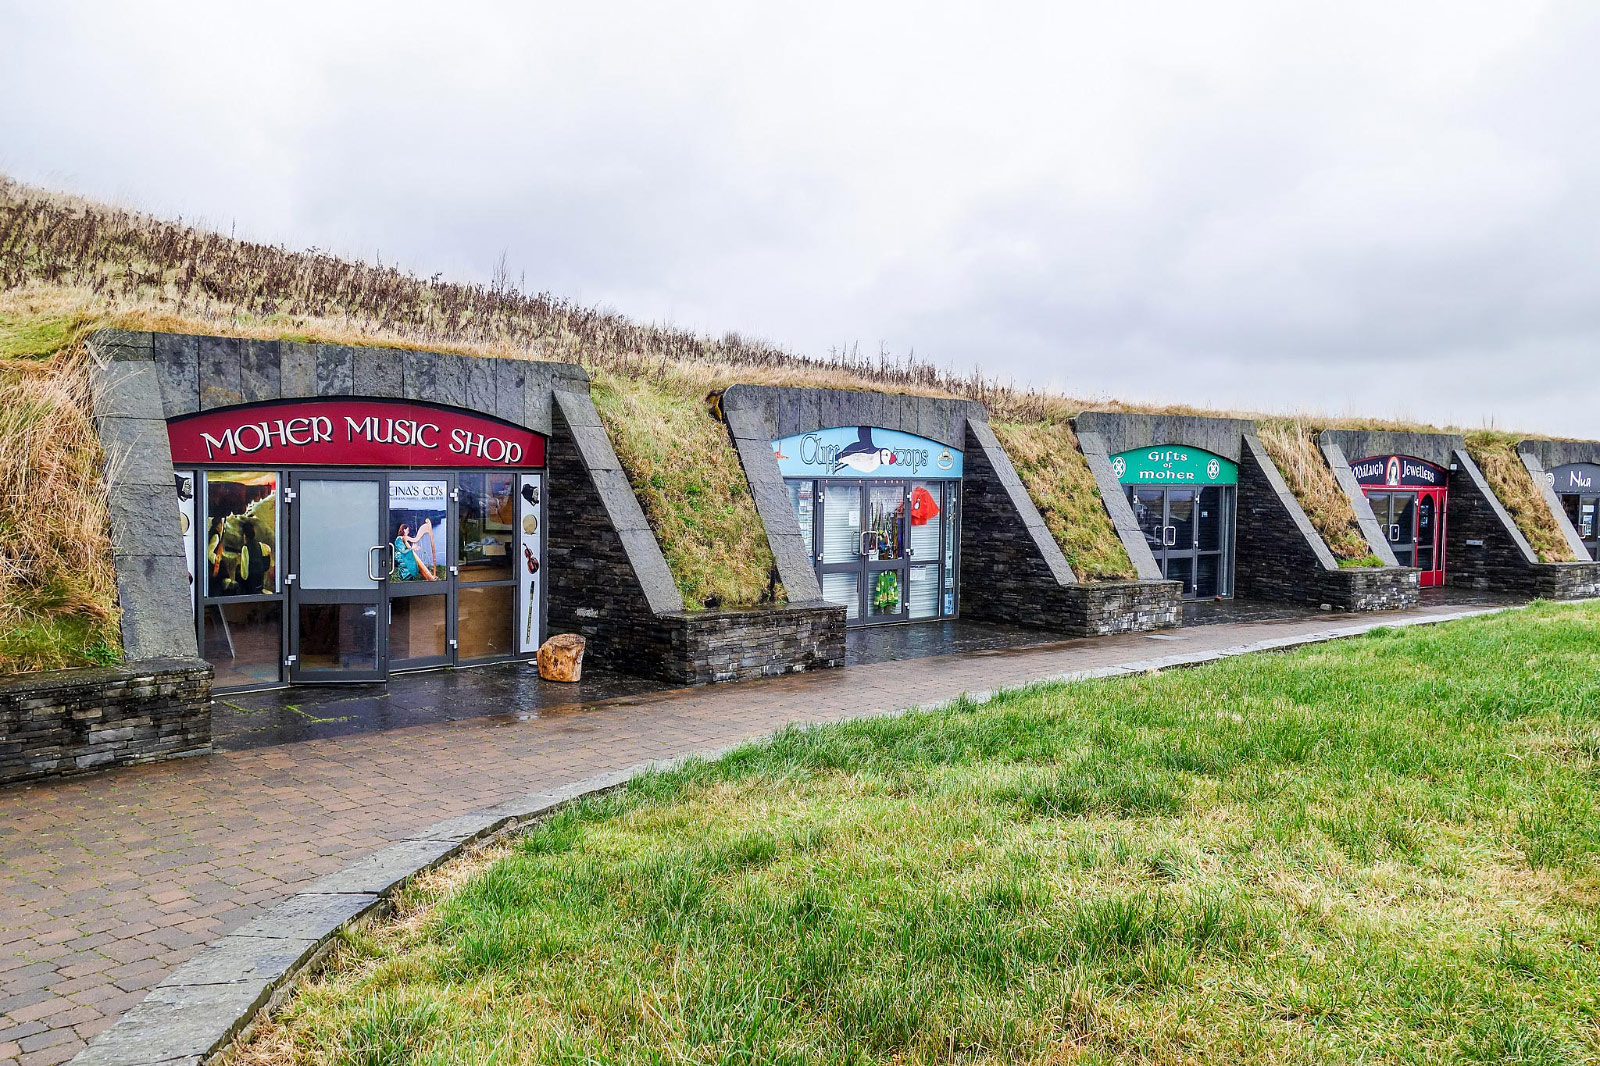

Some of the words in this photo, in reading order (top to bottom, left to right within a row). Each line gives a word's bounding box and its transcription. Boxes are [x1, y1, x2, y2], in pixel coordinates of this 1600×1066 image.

[200, 416, 333, 459] MOHER
[344, 416, 440, 449] MUSIC
[449, 428, 522, 464] SHOP
[1148, 451, 1188, 461] Gifts
